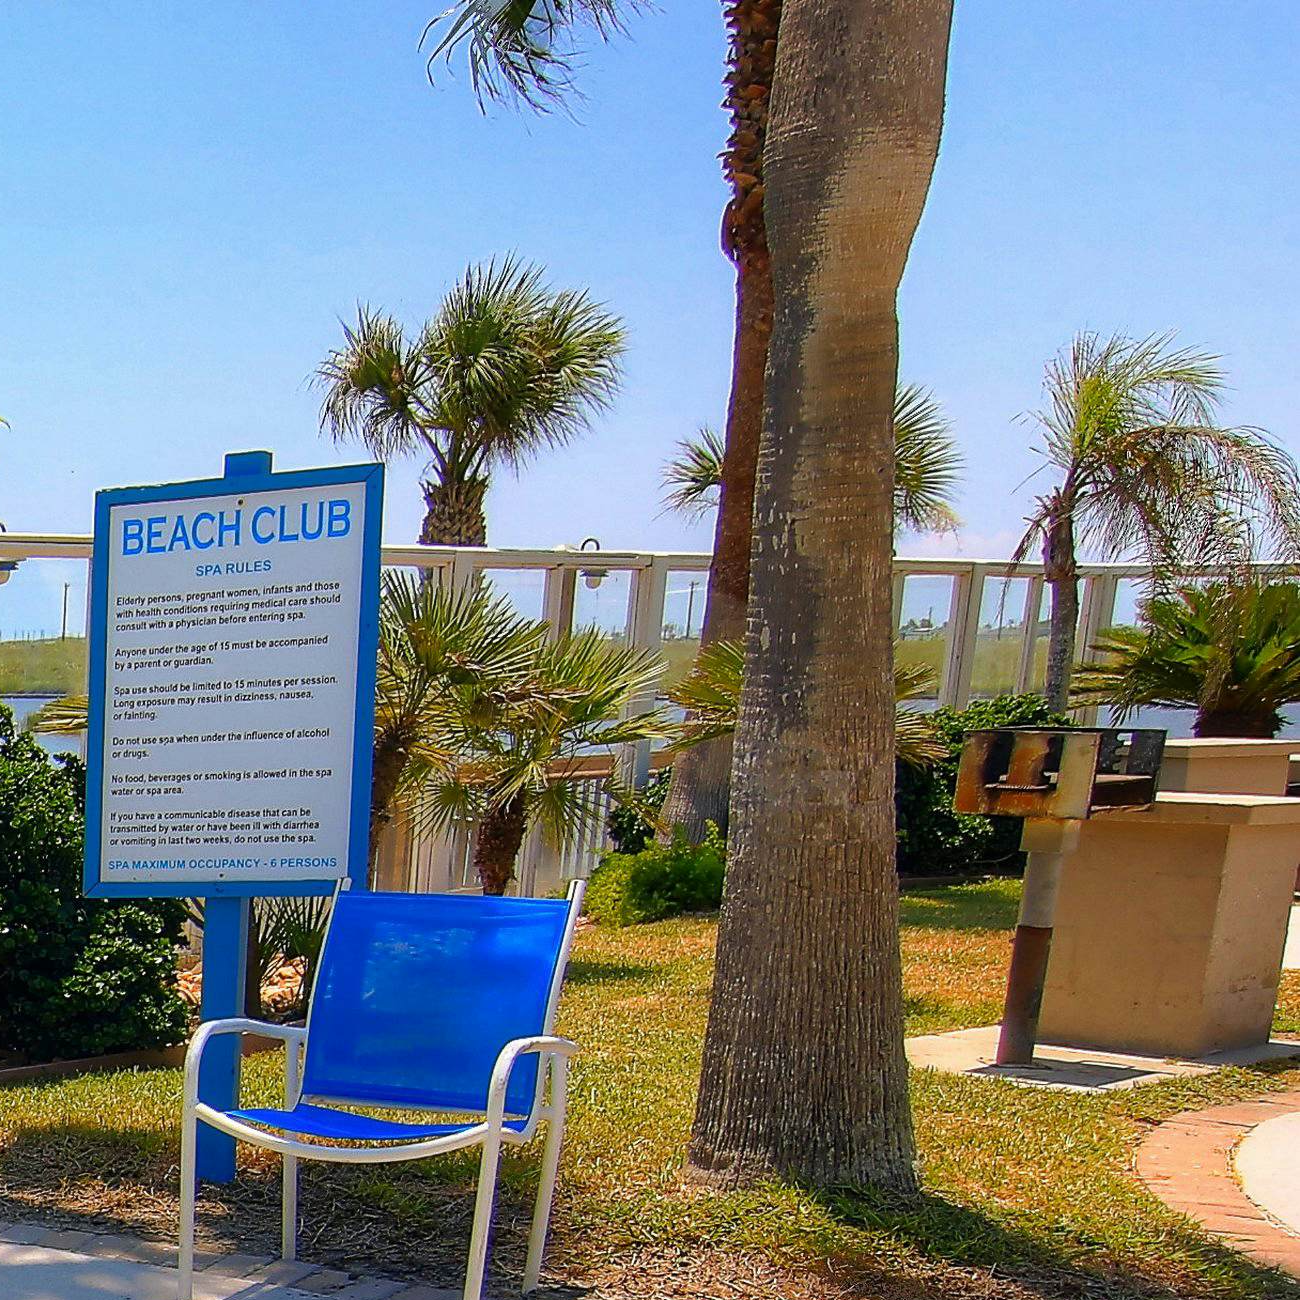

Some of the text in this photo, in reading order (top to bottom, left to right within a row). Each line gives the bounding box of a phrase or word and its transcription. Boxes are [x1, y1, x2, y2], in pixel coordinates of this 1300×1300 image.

[122, 499, 352, 556] BEACH CLUB
[196, 560, 271, 576] SPA RULES
[116, 596, 145, 606] Elderly
[186, 590, 224, 602] pregnant
[227, 589, 260, 597] women,
[263, 585, 292, 595] infants
[295, 584, 312, 592] and
[314, 582, 339, 591] those
[116, 594, 340, 619] with health conditions requiring medical care should
[116, 621, 147, 631] consult
[149, 620, 166, 629] with
[176, 617, 216, 629] physician
[219, 614, 246, 624] before
[249, 612, 284, 623] entering
[287, 611, 306, 621] spa.
[115, 636, 328, 658] Anyone under the age of 15 must be accompanied
[115, 661, 124, 671] by
[134, 660, 160, 671] parent
[163, 659, 171, 667] or
[174, 656, 213, 668] guardian.
[114, 675, 338, 697] Spa use should be limited to 15 minutes per session.
[114, 699, 134, 709] Long
[137, 697, 175, 707] exposure
[178, 697, 195, 706] may
[198, 695, 222, 704] result
[224, 694, 232, 703] in
[124, 710, 157, 721] fainting.
[113, 729, 330, 746] Do not use spa when under the influence of alcohol
[112, 748, 149, 759] or drugs.
[112, 768, 332, 784] No food, beverages or smoking is allowed in the spa
[111, 786, 184, 796] water or spa area.
[110, 812, 116, 821] If
[118, 812, 133, 822] you
[136, 811, 155, 820] have
[164, 809, 225, 820] communicable
[228, 807, 260, 817] disease
[263, 808, 279, 816] that
[300, 807, 310, 816] be
[110, 823, 157, 833] transmitted
[159, 823, 169, 833] by
[171, 822, 194, 832] water
[196, 823, 206, 831] or
[207, 821, 227, 830] have
[230, 820, 251, 830] been
[263, 819, 281, 829] with
[283, 818, 319, 828] diarrhea
[110, 833, 316, 846] or vomiting in last two weeks, do not use the spa.
[109, 860, 130, 870] SPA
[132, 860, 185, 869] MAXIMUM
[189, 859, 260, 869] OCCUPANCY
[270, 859, 276, 867] 6
[281, 858, 336, 868] PERSONS
